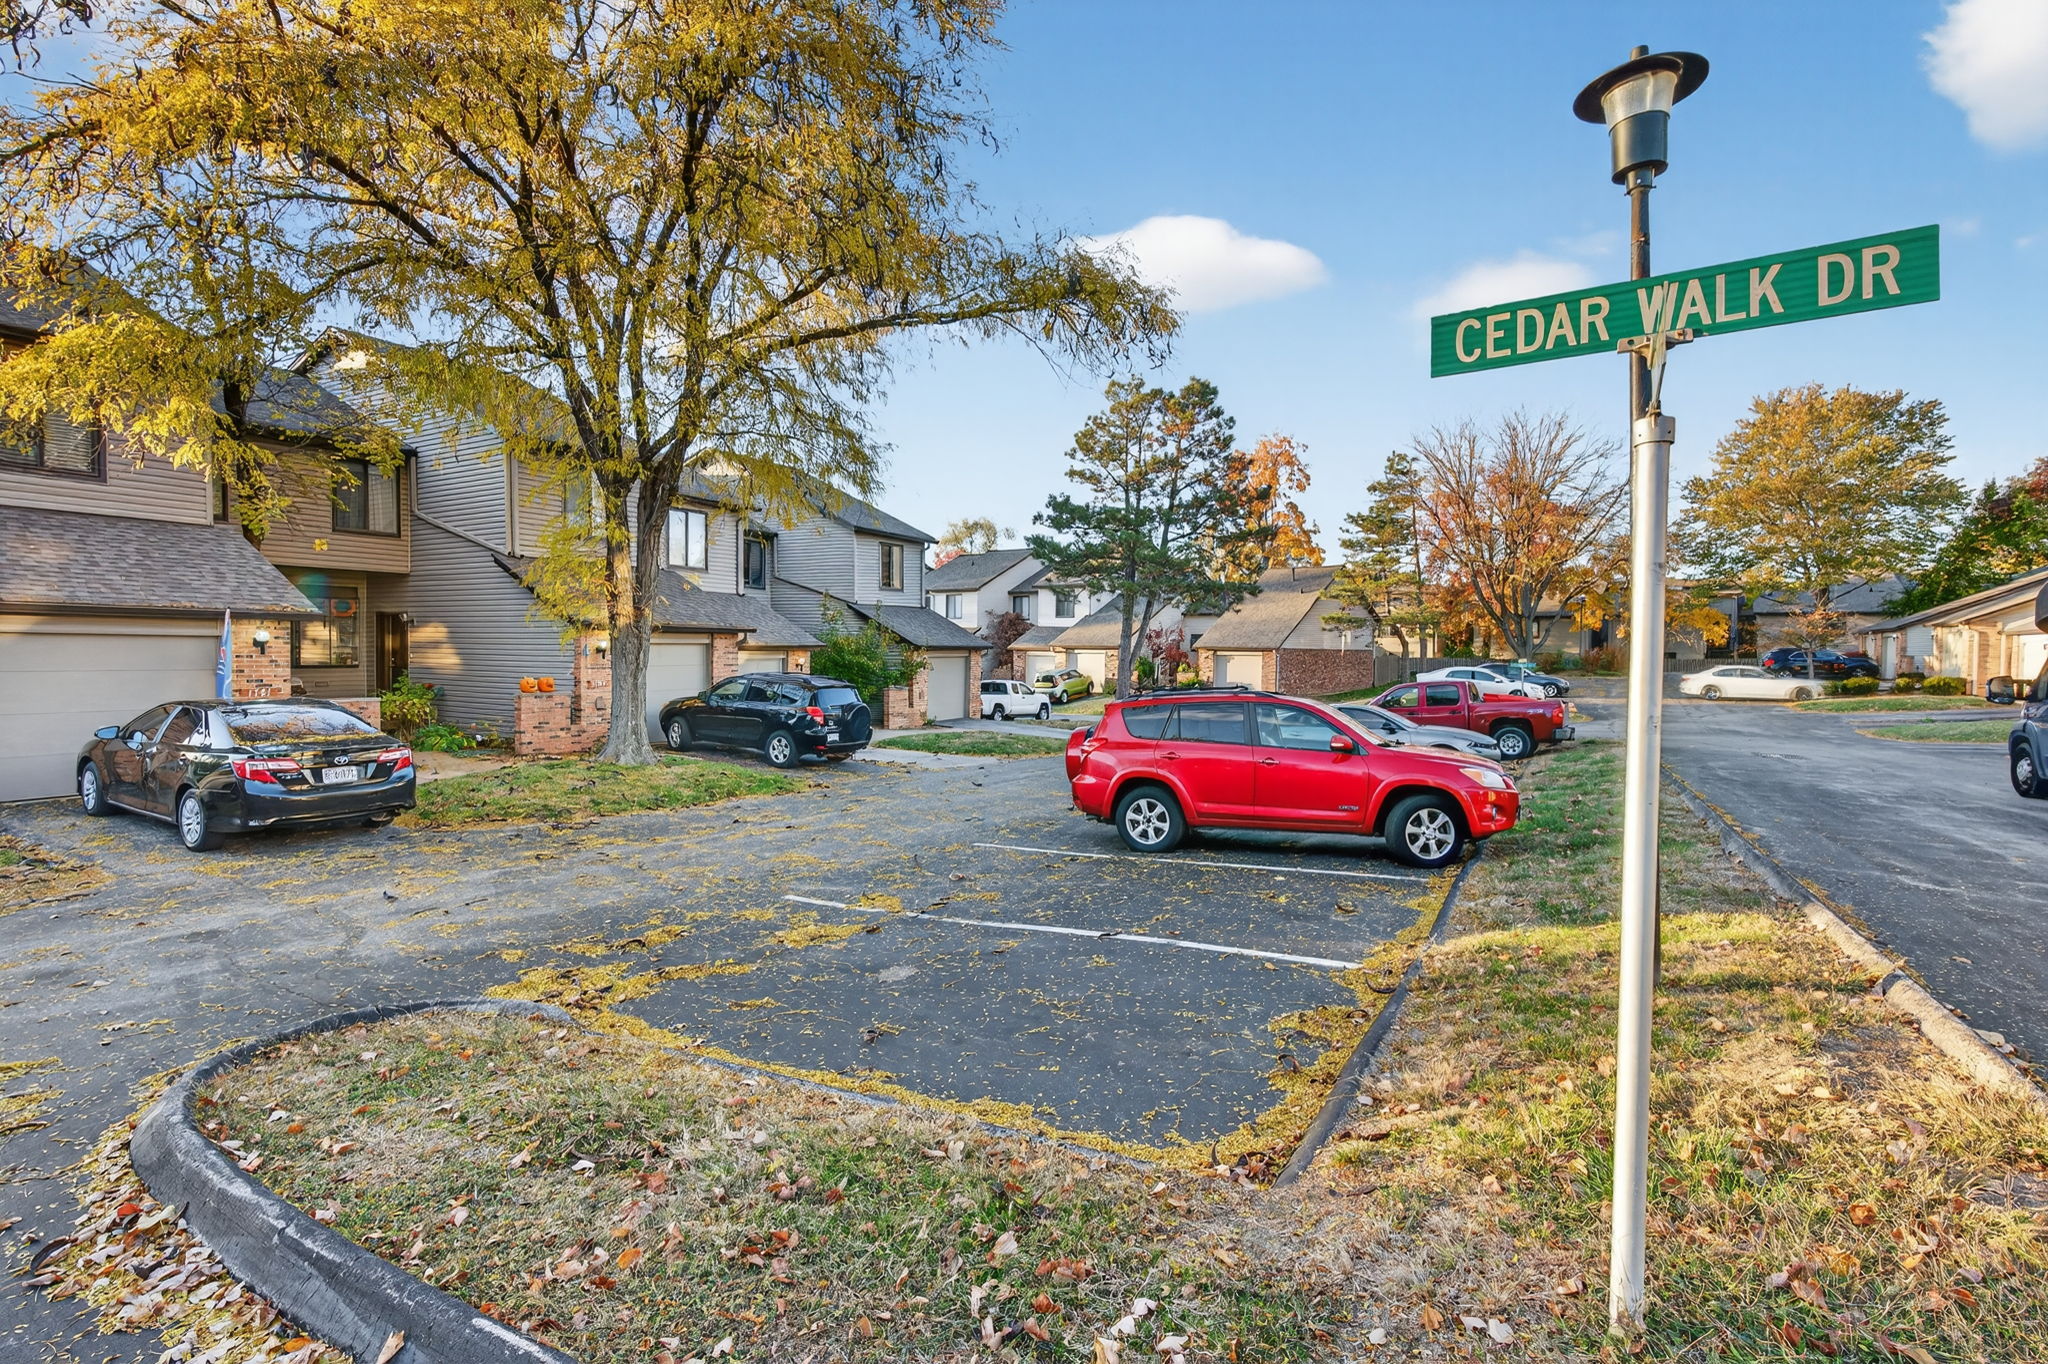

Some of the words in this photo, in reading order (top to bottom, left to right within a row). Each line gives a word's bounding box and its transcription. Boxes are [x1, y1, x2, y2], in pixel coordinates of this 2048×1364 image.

[1455, 296, 1610, 363] CEDAR
[1637, 263, 1785, 334] WALK
[1817, 244, 1901, 306] DR
